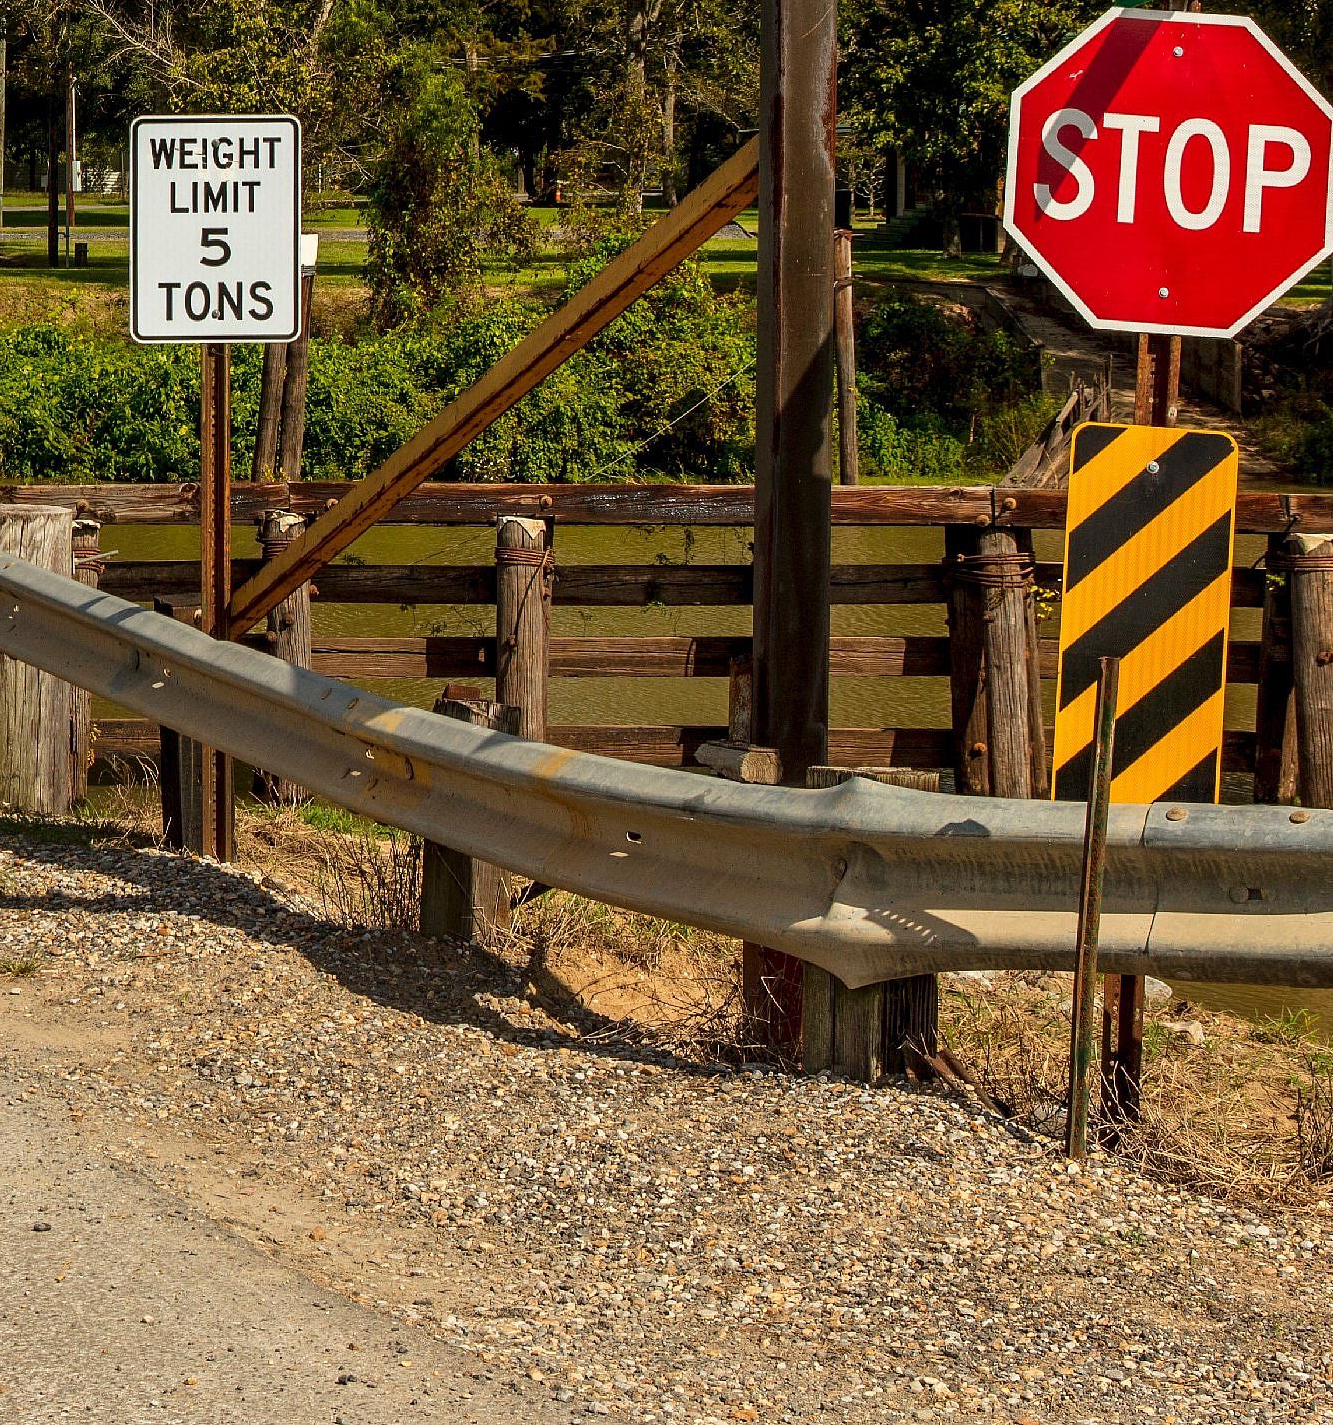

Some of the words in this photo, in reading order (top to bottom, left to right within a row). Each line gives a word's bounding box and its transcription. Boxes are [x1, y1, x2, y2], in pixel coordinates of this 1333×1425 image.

[149, 136, 282, 170] WEIGHT
[1033, 108, 1312, 234] STOP
[170, 181, 261, 214] LIMIT
[200, 228, 232, 267] 5
[157, 280, 274, 321] TONS
